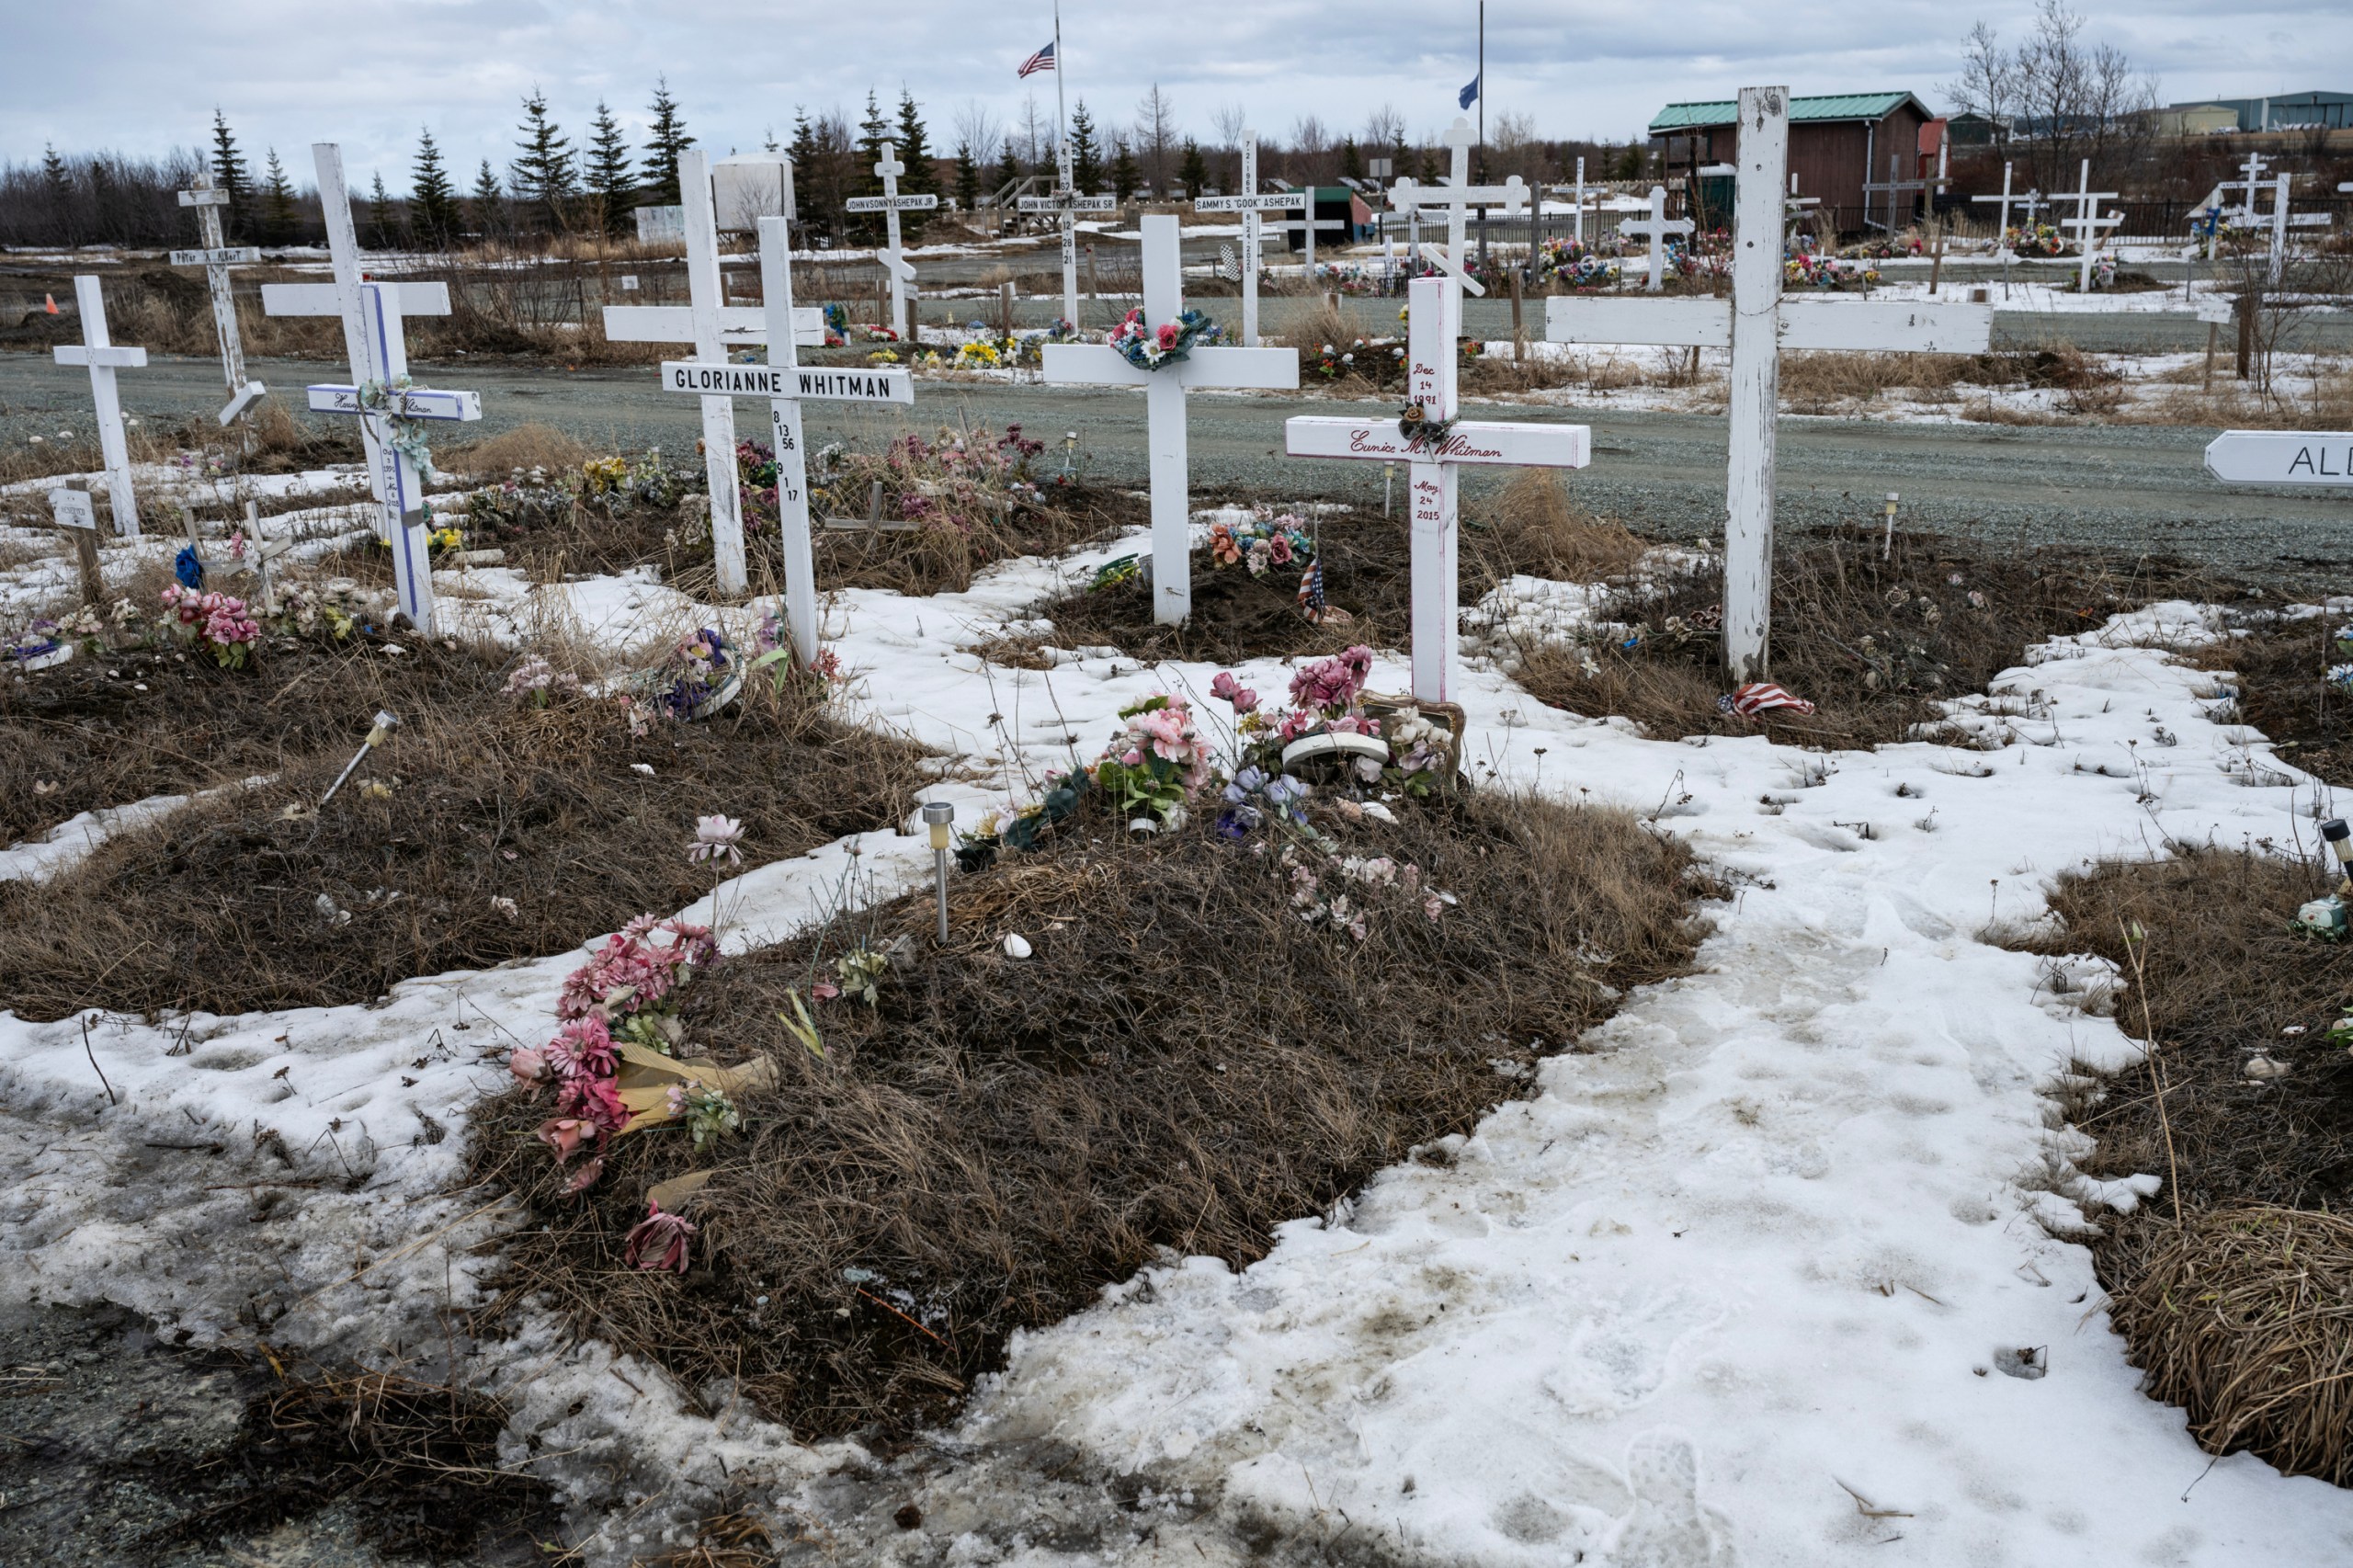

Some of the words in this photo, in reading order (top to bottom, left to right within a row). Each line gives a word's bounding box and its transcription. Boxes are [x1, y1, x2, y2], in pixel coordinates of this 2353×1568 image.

[847, 200, 865, 210] JOHN
[893, 197, 923, 208] ASHEPAK
[925, 197, 933, 207] JR
[1019, 199, 1038, 210] JOHN
[1040, 199, 1066, 210] VICTOR
[1068, 199, 1101, 209] ASHEPAK
[1103, 199, 1113, 209] SR
[1197, 199, 1223, 210] SAMMY
[1234, 198, 1261, 208] "GOOK"
[1264, 197, 1301, 207] ASHEPAK
[1063, 238, 1072, 246] 28
[1064, 255, 1072, 264] 21
[1413, 363, 1435, 375] Dec
[676, 369, 781, 392] GLORIANNE
[799, 373, 890, 397] WHITMAN
[1420, 381, 1432, 390] 14
[1414, 395, 1437, 405] 1991
[773, 411, 779, 423] 8
[779, 425, 790, 437] 13
[782, 437, 794, 449] 56
[1350, 429, 1396, 454] Eunice
[1435, 434, 1503, 457] Whitman
[777, 461, 783, 475] 9
[1414, 481, 1439, 494] May
[788, 490, 798, 501] 17
[1419, 496, 1433, 505] 24
[1417, 510, 1440, 520] 2015
